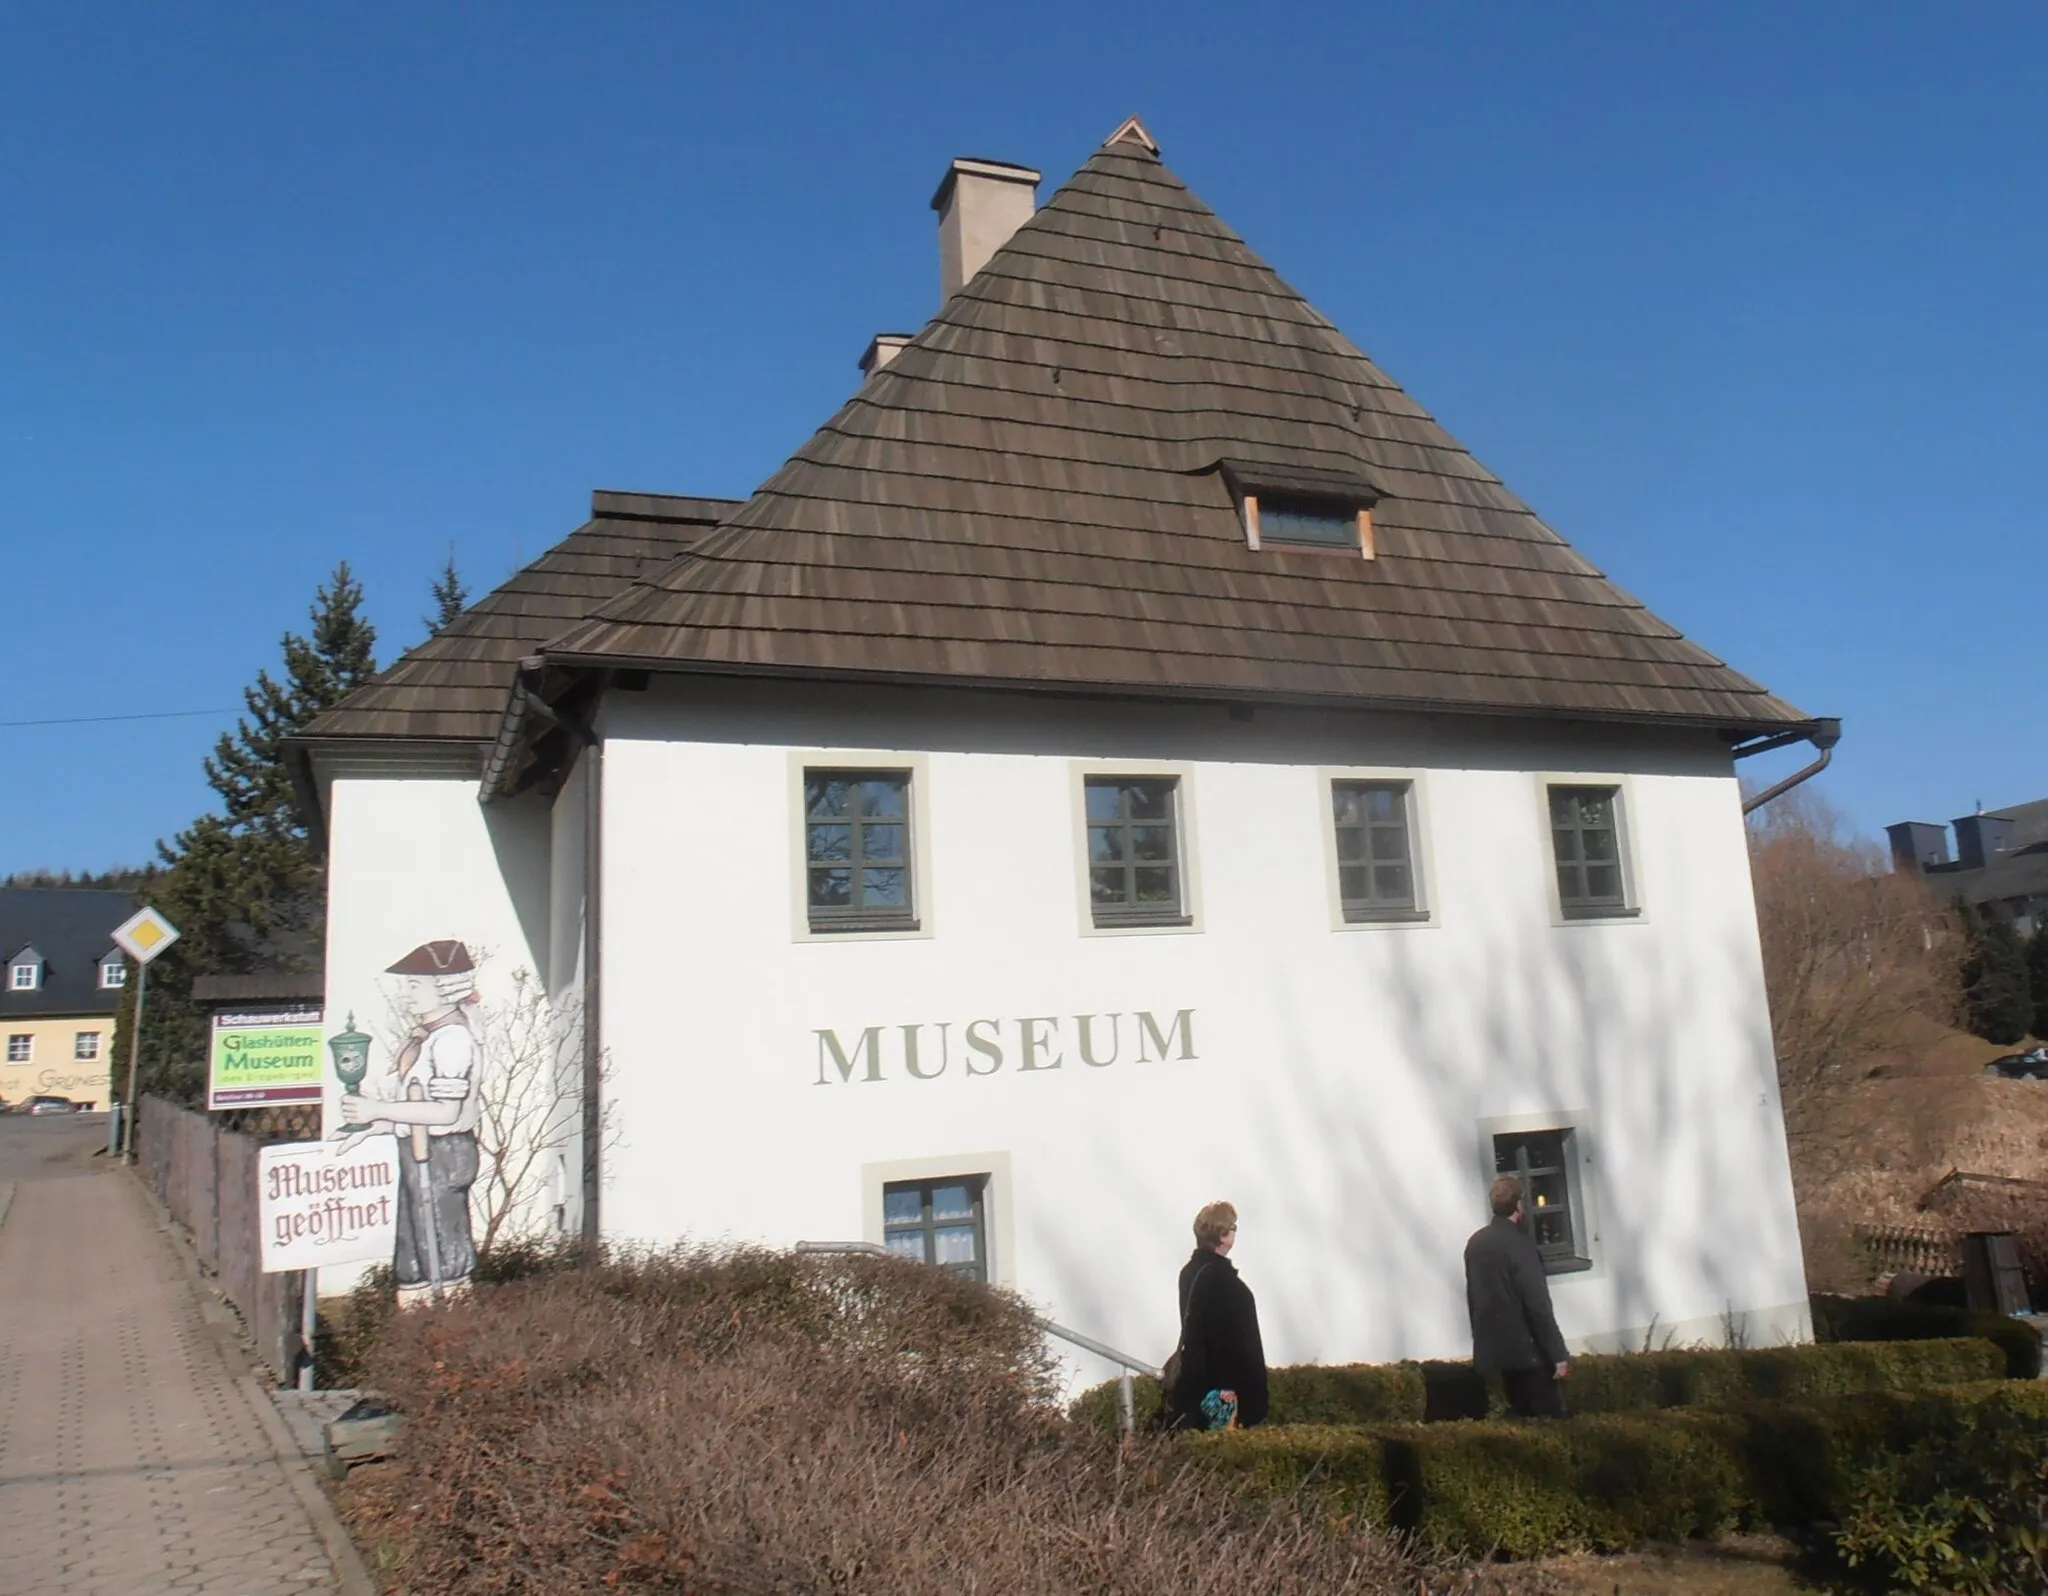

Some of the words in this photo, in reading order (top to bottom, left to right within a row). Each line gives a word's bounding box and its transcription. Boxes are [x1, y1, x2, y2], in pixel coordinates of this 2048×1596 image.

[222, 1034, 320, 1052] Glashütten-
[223, 1052, 314, 1071] Museum
[811, 1009, 1199, 1085] MUSEUM
[268, 1161, 392, 1201] Museum
[273, 1195, 391, 1248] geöffnet
